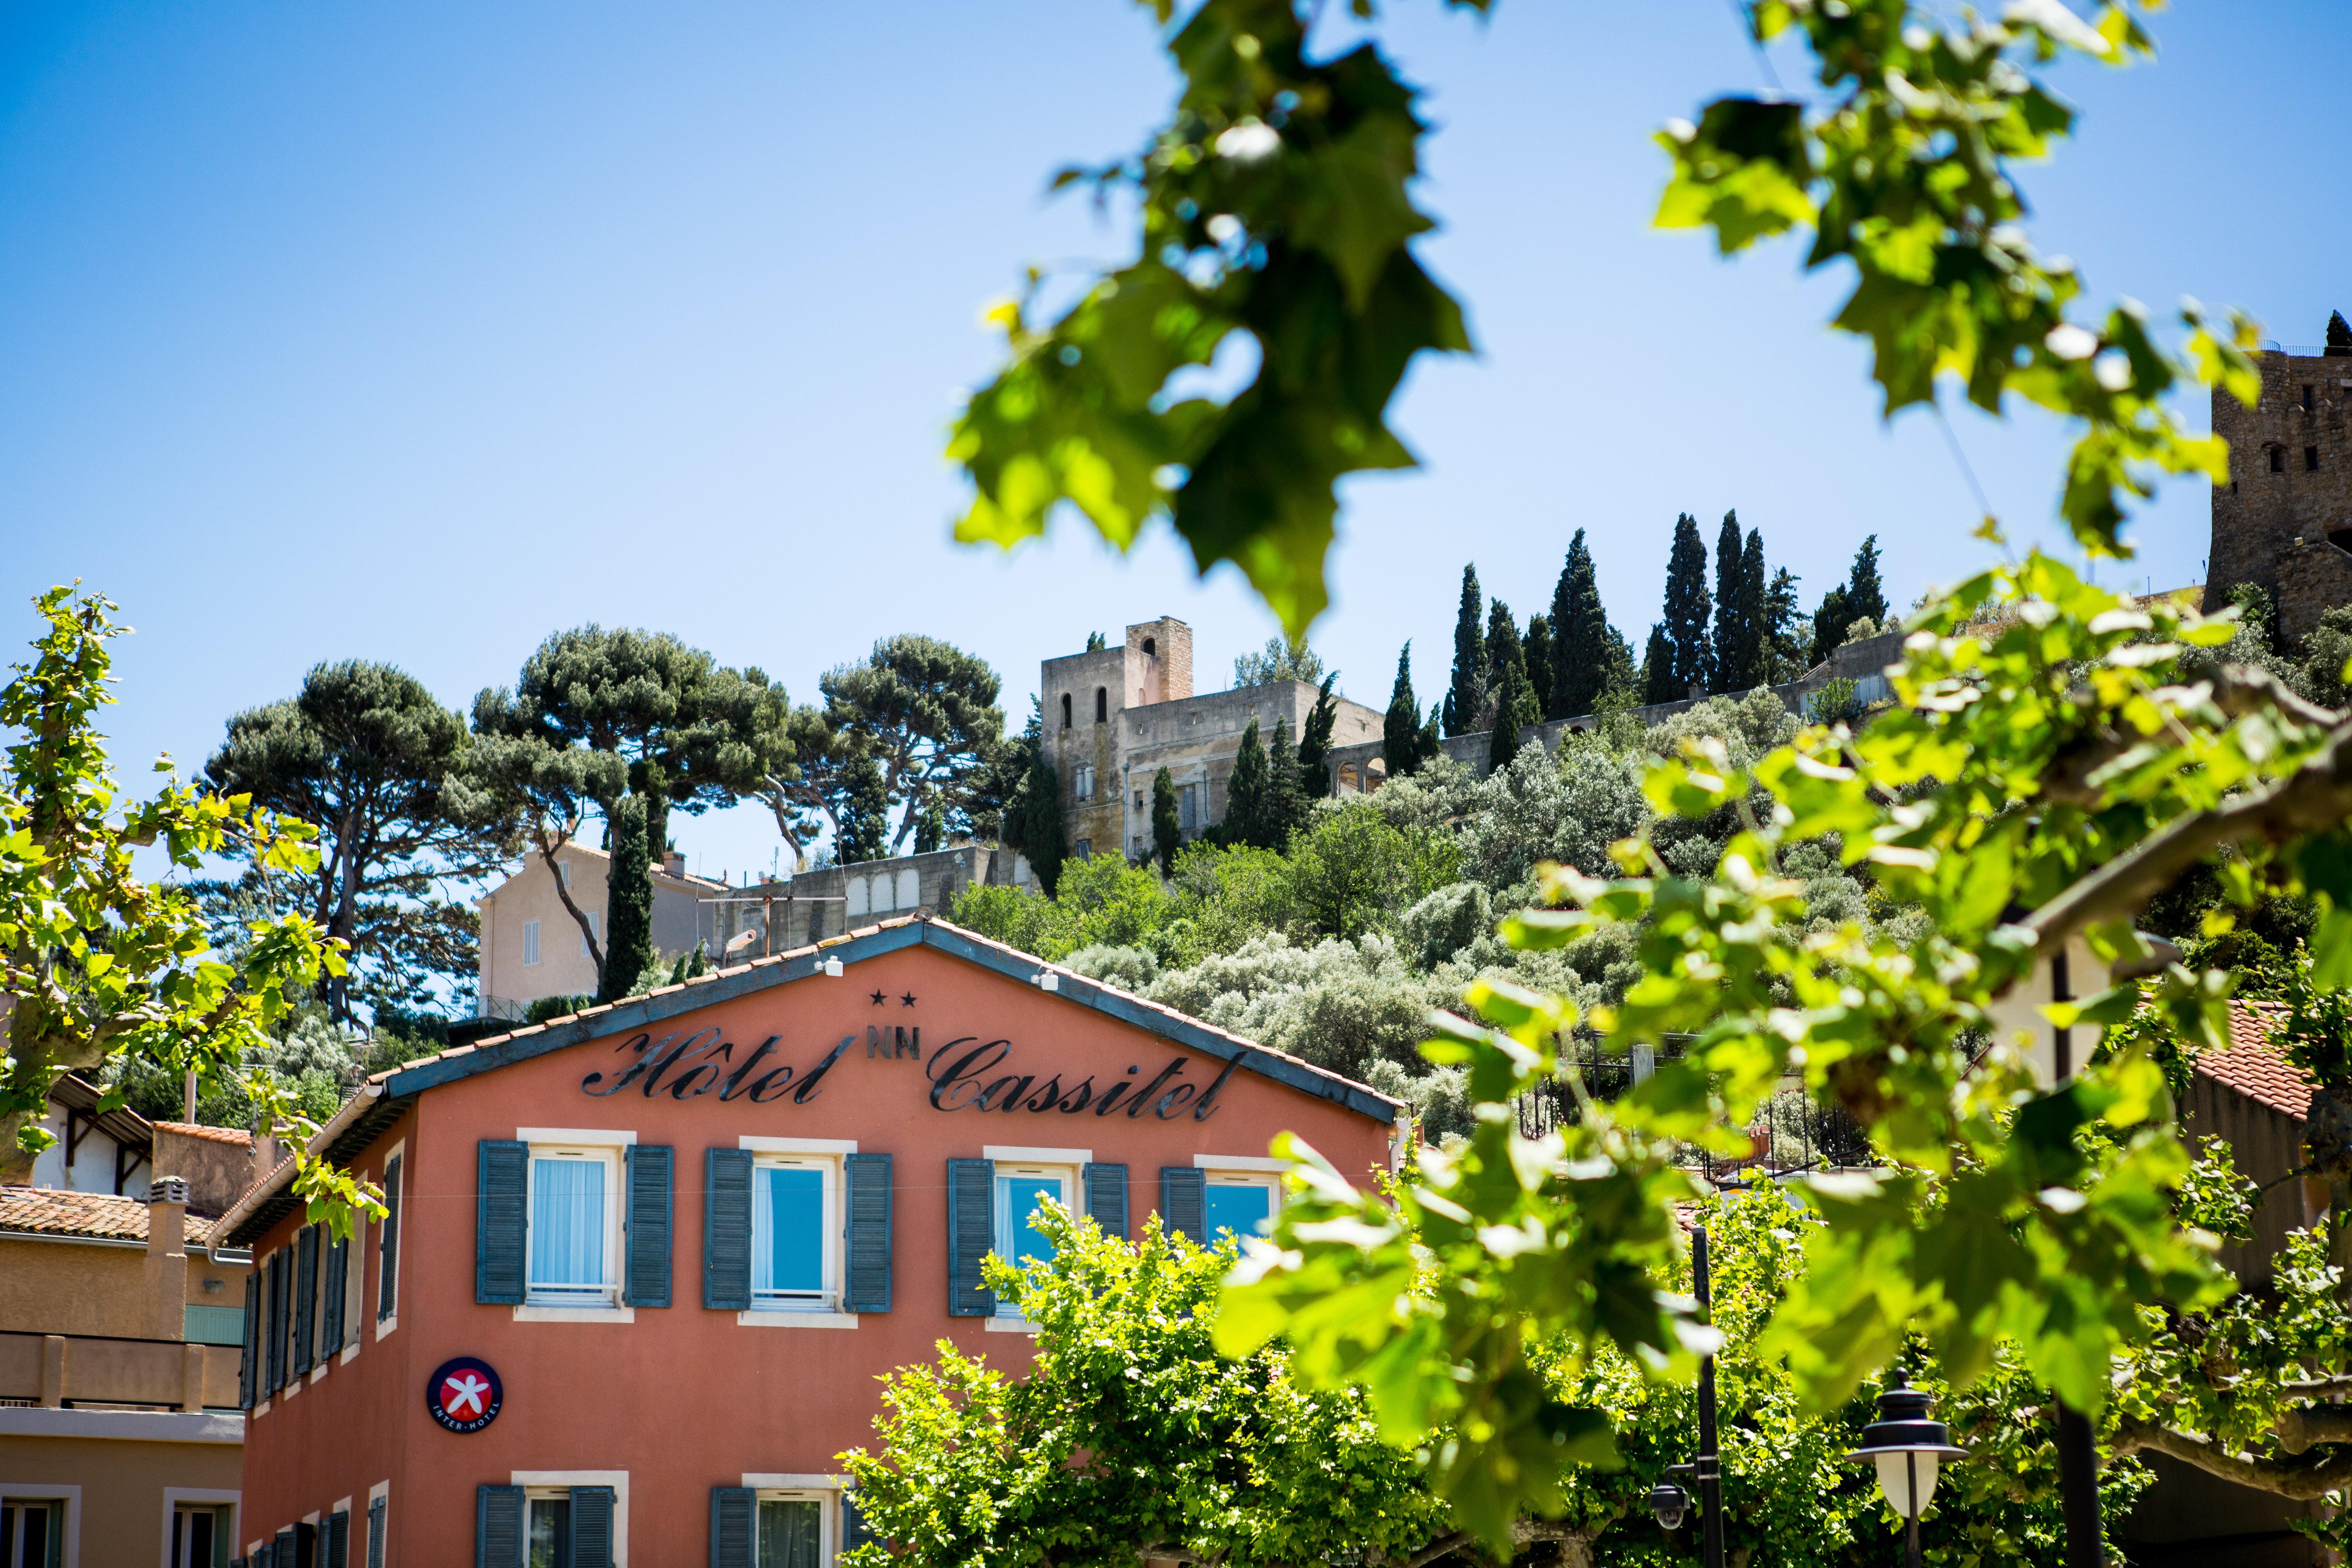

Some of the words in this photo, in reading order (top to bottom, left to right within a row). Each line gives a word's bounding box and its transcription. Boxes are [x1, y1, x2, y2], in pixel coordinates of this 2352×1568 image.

[867, 1025, 920, 1061] NN
[582, 1026, 857, 1105] Hôtel
[926, 1036, 1249, 1123] Cassitel
[433, 1403, 499, 1430] INTER-HOTEL
